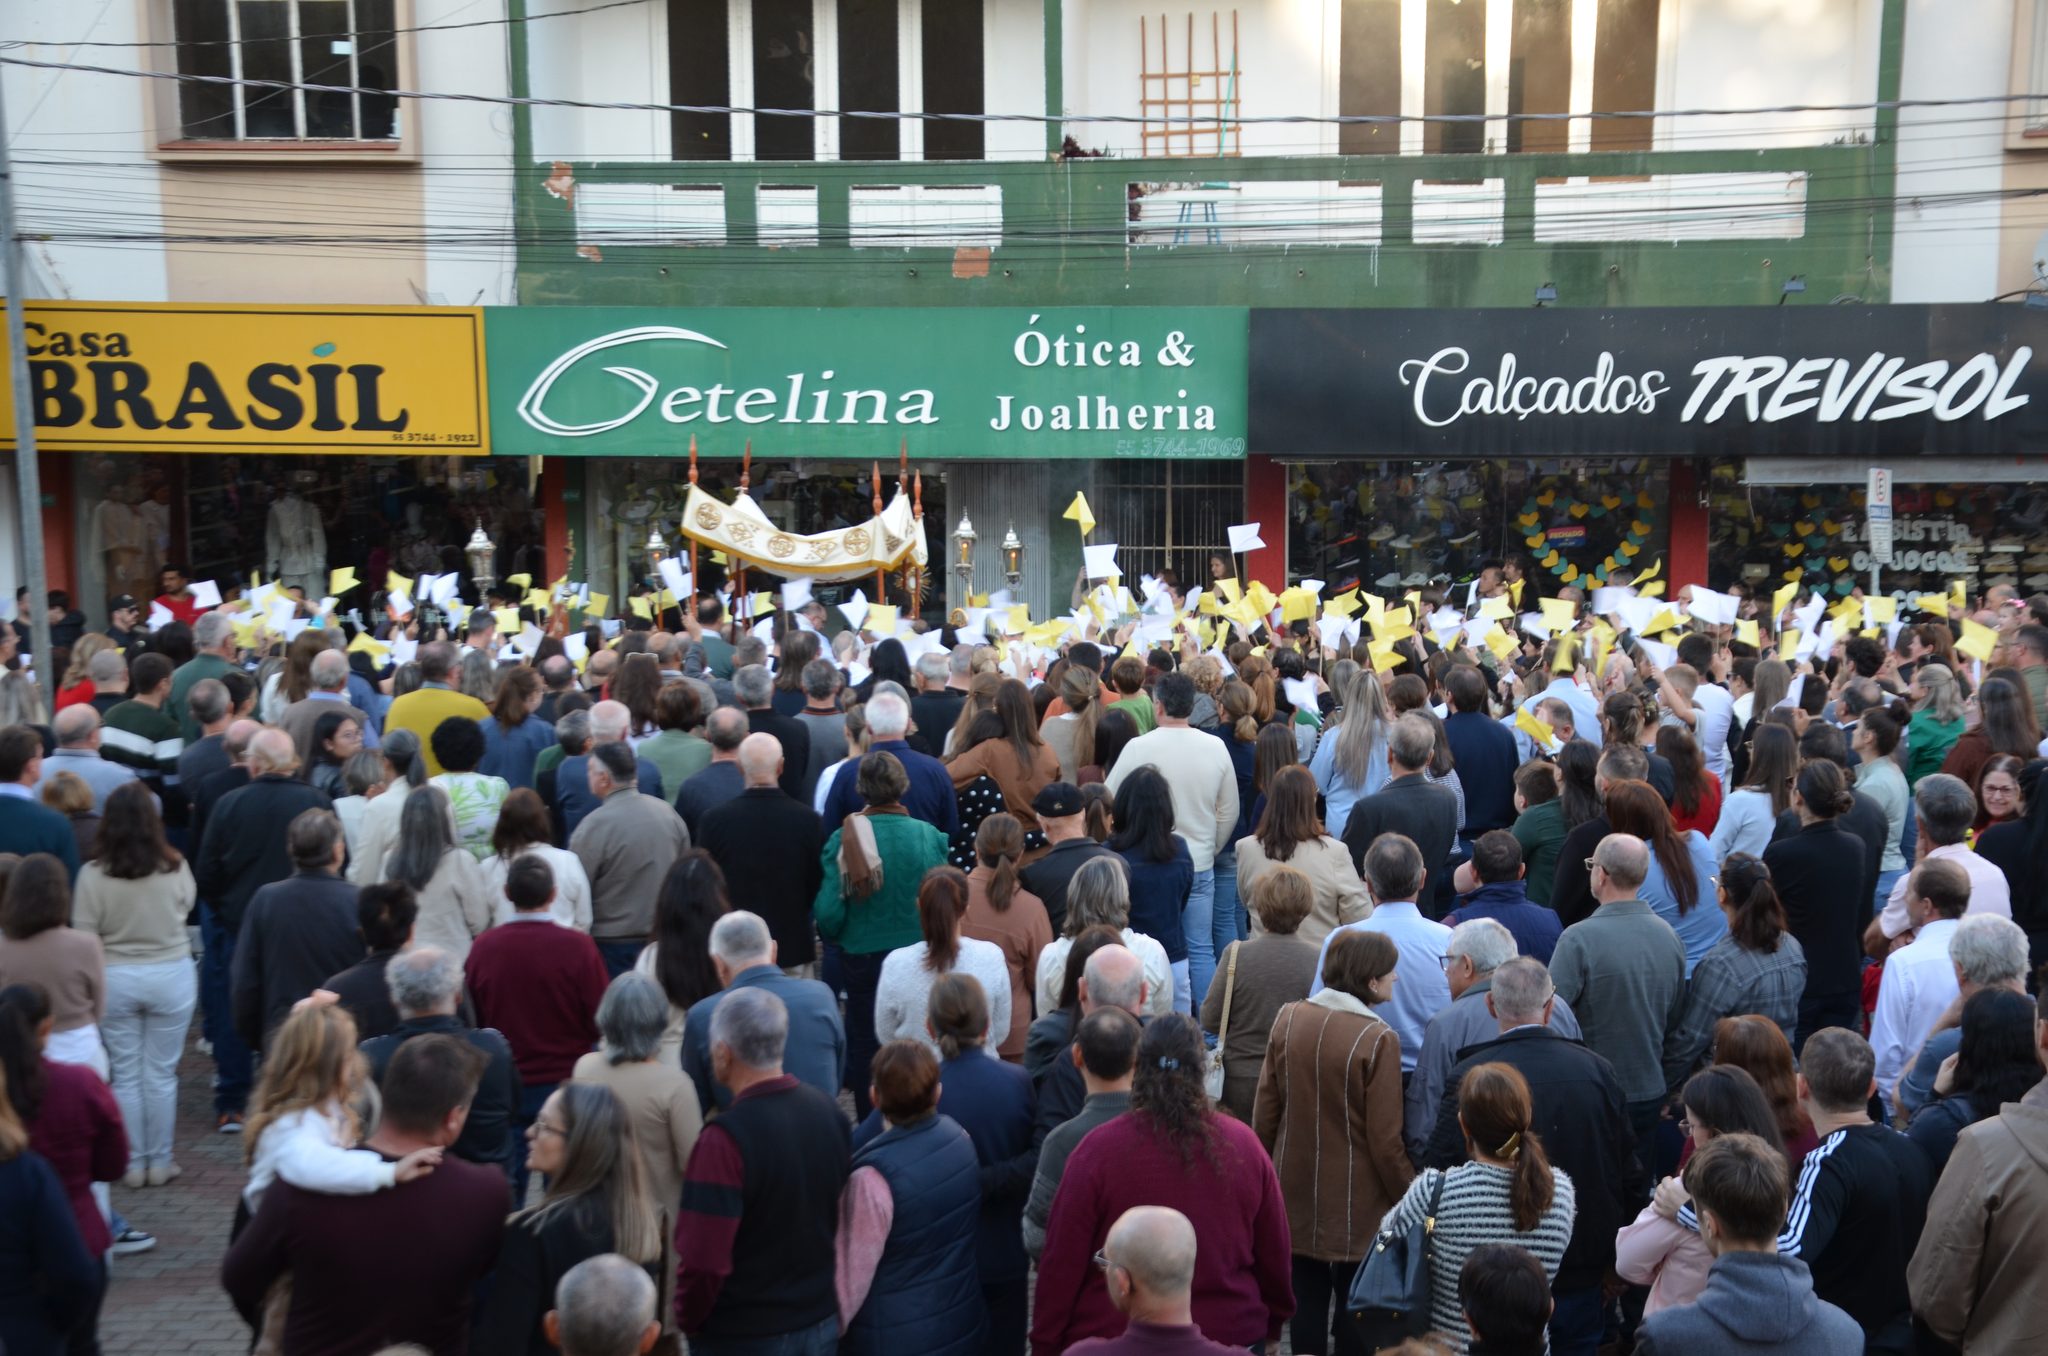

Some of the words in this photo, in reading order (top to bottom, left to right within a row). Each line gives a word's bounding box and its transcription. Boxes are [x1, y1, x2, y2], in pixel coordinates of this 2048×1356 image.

[24, 321, 132, 358] Casa
[1014, 313, 1142, 367] Ótica
[1157, 330, 1195, 367] &
[26, 344, 409, 433] BRASIL
[517, 325, 939, 437] Getelina
[1398, 346, 1671, 427] Calçados
[1680, 345, 2033, 424] TREVISOL
[990, 389, 1216, 431] Joalheria
[407, 432, 437, 442] 3744
[447, 433, 476, 442] 1922
[1140, 437, 1246, 457] 3744-1969
